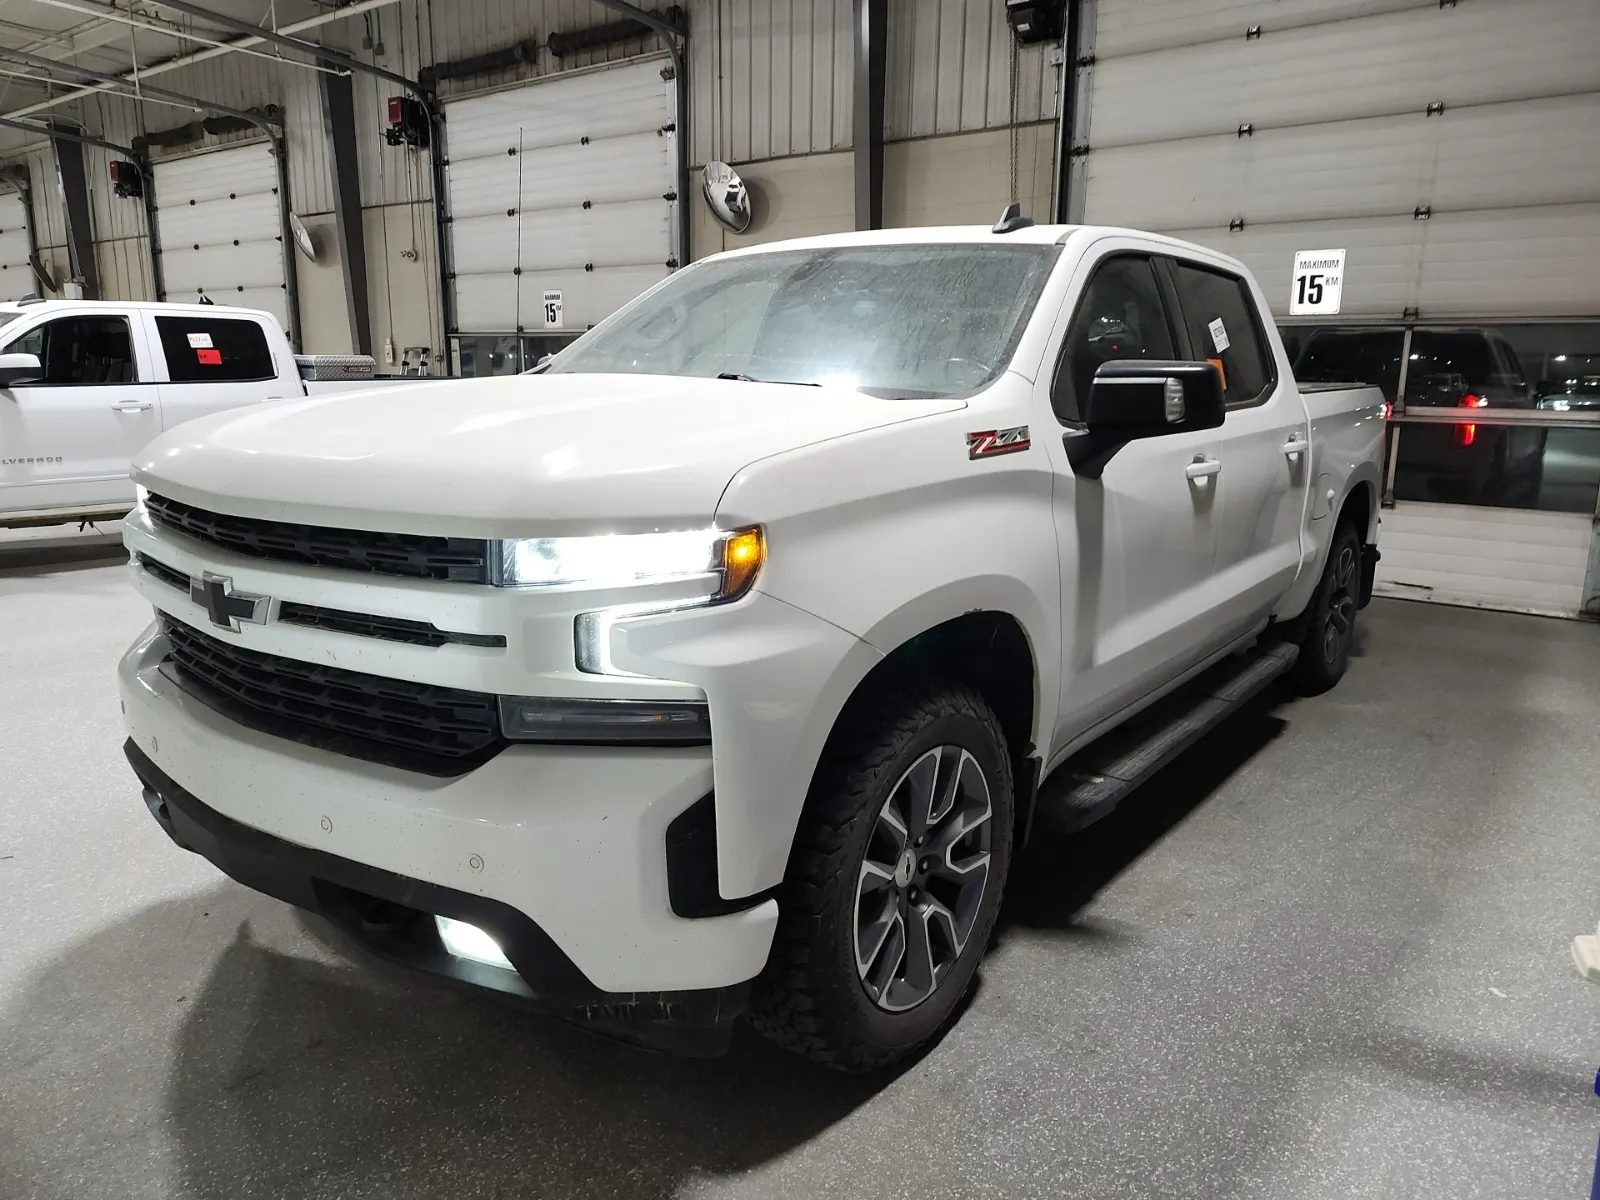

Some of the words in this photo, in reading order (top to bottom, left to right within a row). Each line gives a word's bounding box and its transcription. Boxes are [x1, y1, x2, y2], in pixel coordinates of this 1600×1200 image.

[1300, 260, 1339, 269] MAXIMUM
[1297, 274, 1324, 304] 15
[1325, 276, 1339, 286] KM
[545, 303, 556, 322] 15
[966, 425, 1031, 460] Z71
